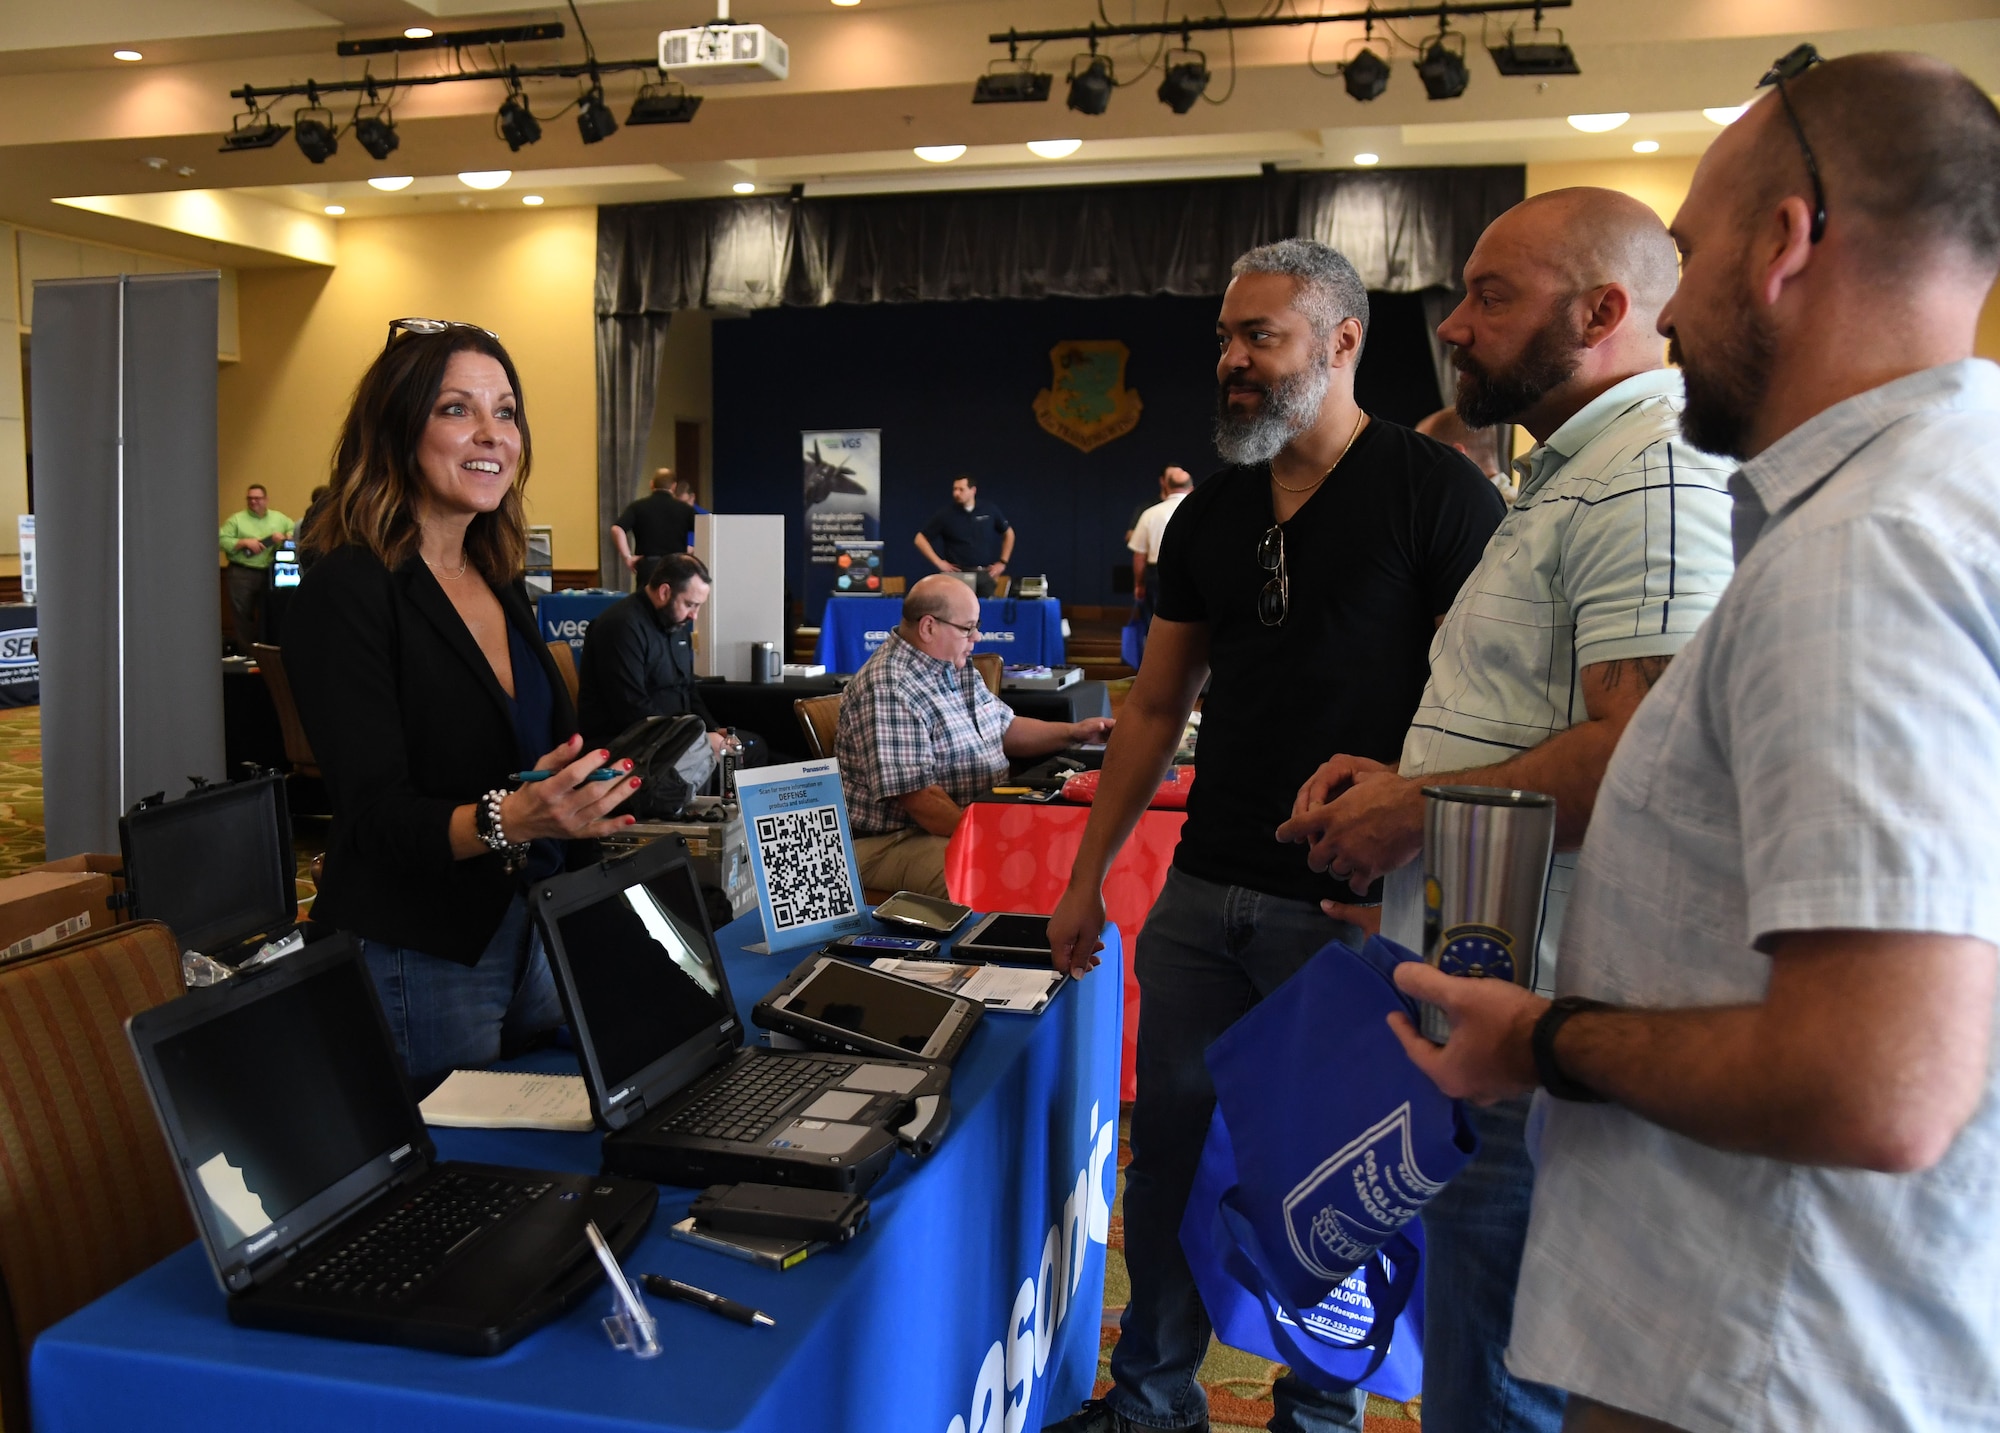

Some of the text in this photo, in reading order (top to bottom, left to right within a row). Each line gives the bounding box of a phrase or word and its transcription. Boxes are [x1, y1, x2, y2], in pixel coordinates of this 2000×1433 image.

[802, 764, 830, 774] Panasonic
[791, 782, 817, 790] information
[778, 790, 808, 801] DEFENSE
[768, 800, 789, 811] products
[1364, 1149, 1379, 1188] YOU
[1352, 1164, 1395, 1226] TODAY'S
[1371, 1185, 1391, 1209] TO
[1310, 1313, 1367, 1337] 1-877-332-3976
